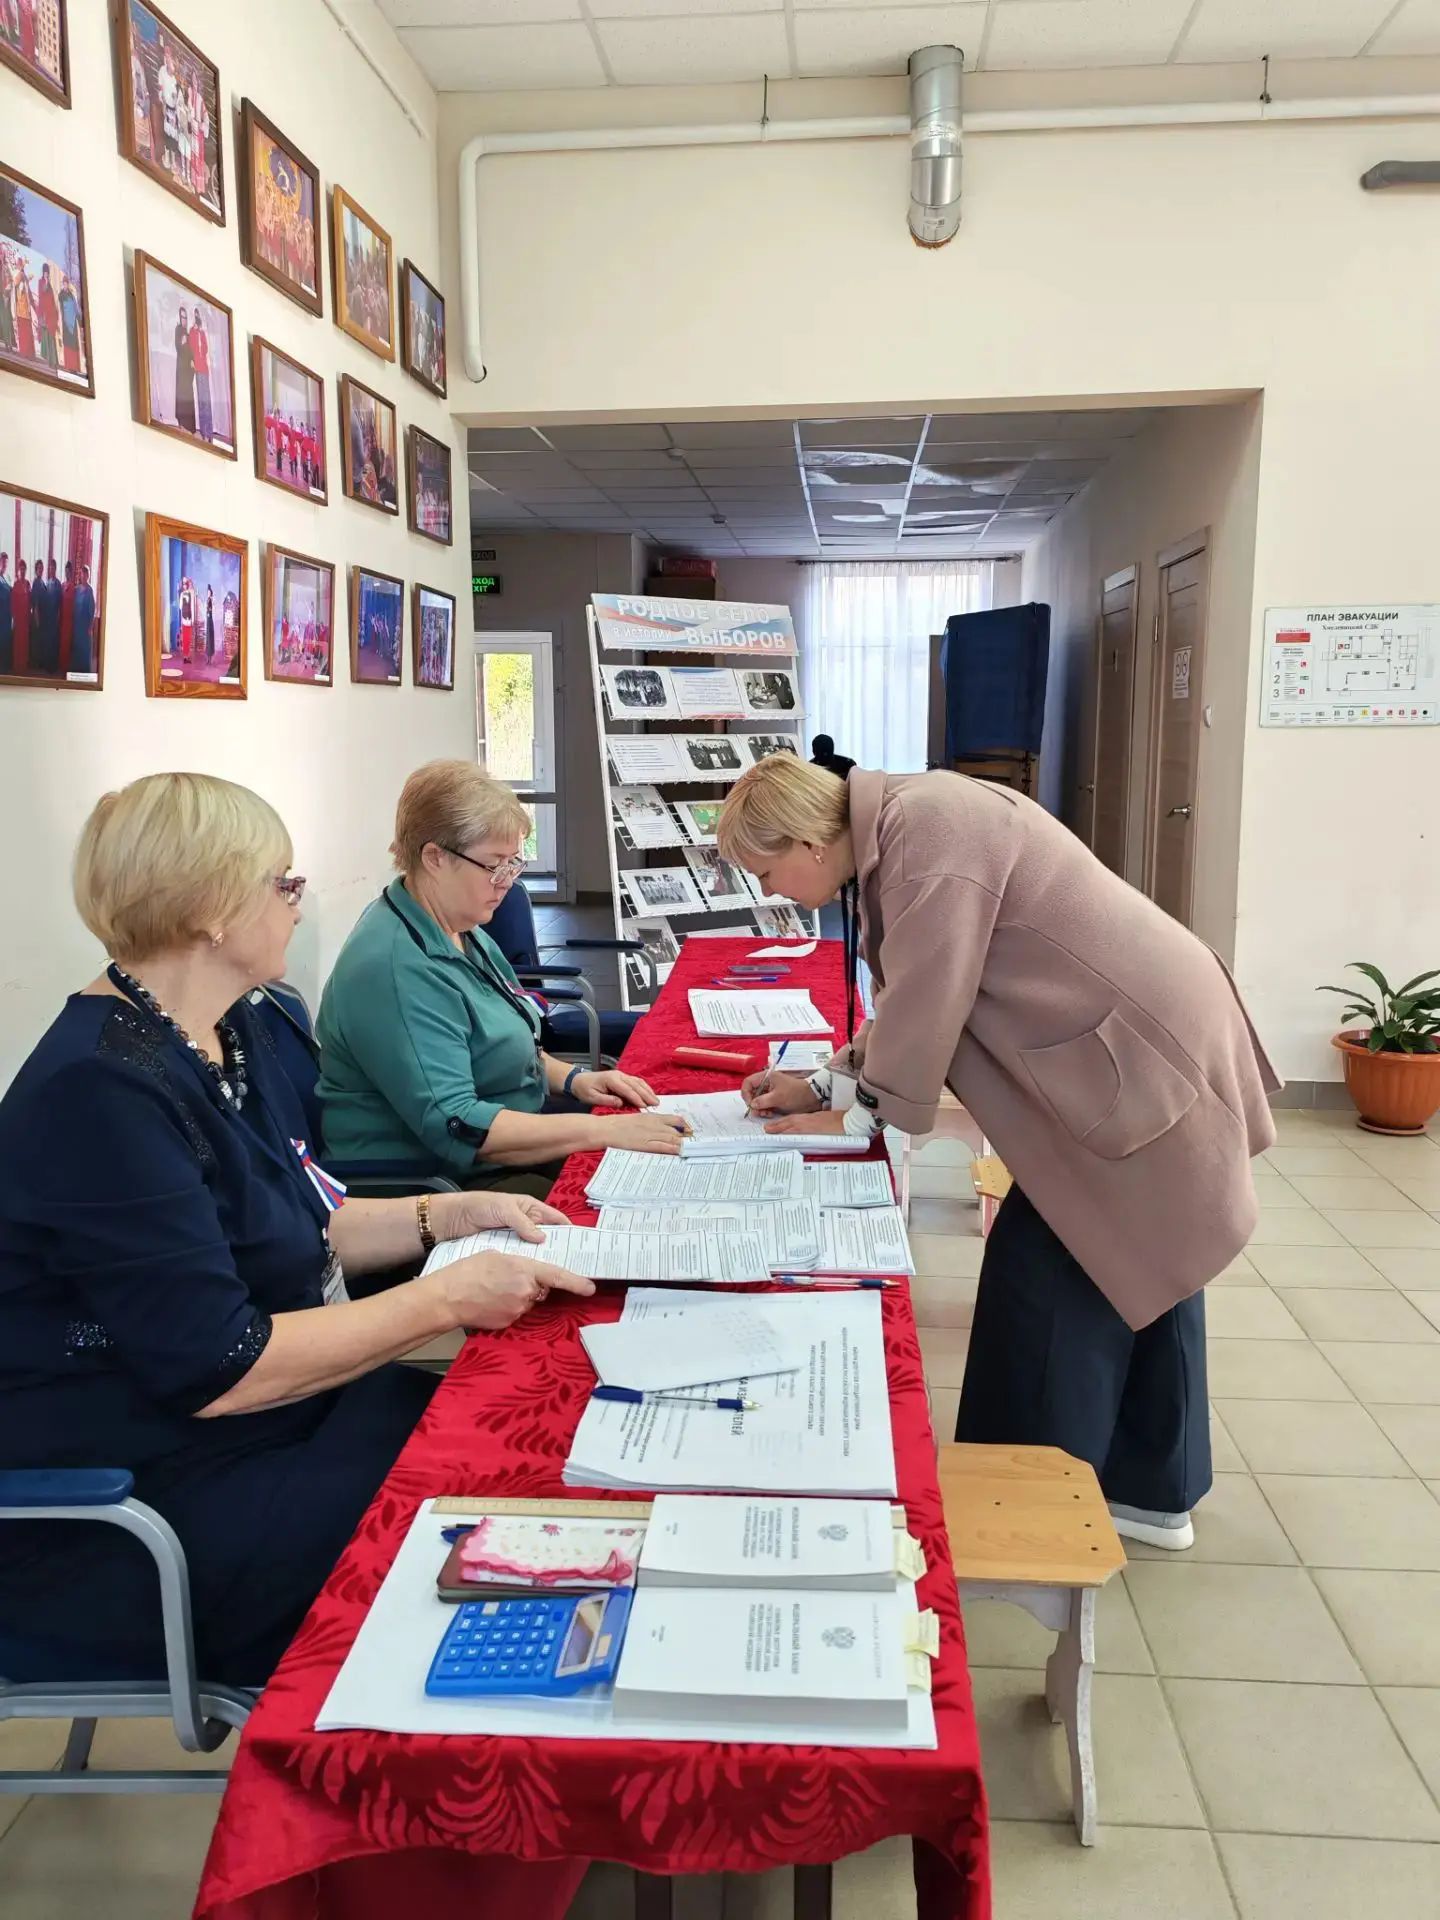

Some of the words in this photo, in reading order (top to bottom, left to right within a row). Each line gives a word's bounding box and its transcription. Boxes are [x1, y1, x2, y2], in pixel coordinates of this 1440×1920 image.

[617, 600, 709, 621] РОДНОЕ
[715, 603, 769, 623] СЕЛО
[1307, 613, 1334, 621] ПЛАН
[1338, 612, 1399, 621] ЭВАКУАЦИИ
[685, 627, 786, 649] ВЫБОРОВ
[1275, 660, 1280, 670] 1
[1273, 674, 1280, 684] 2
[1273, 688, 1280, 698] 3
[731, 1387, 747, 1436] ИЗБАТЕЛЕЙ
